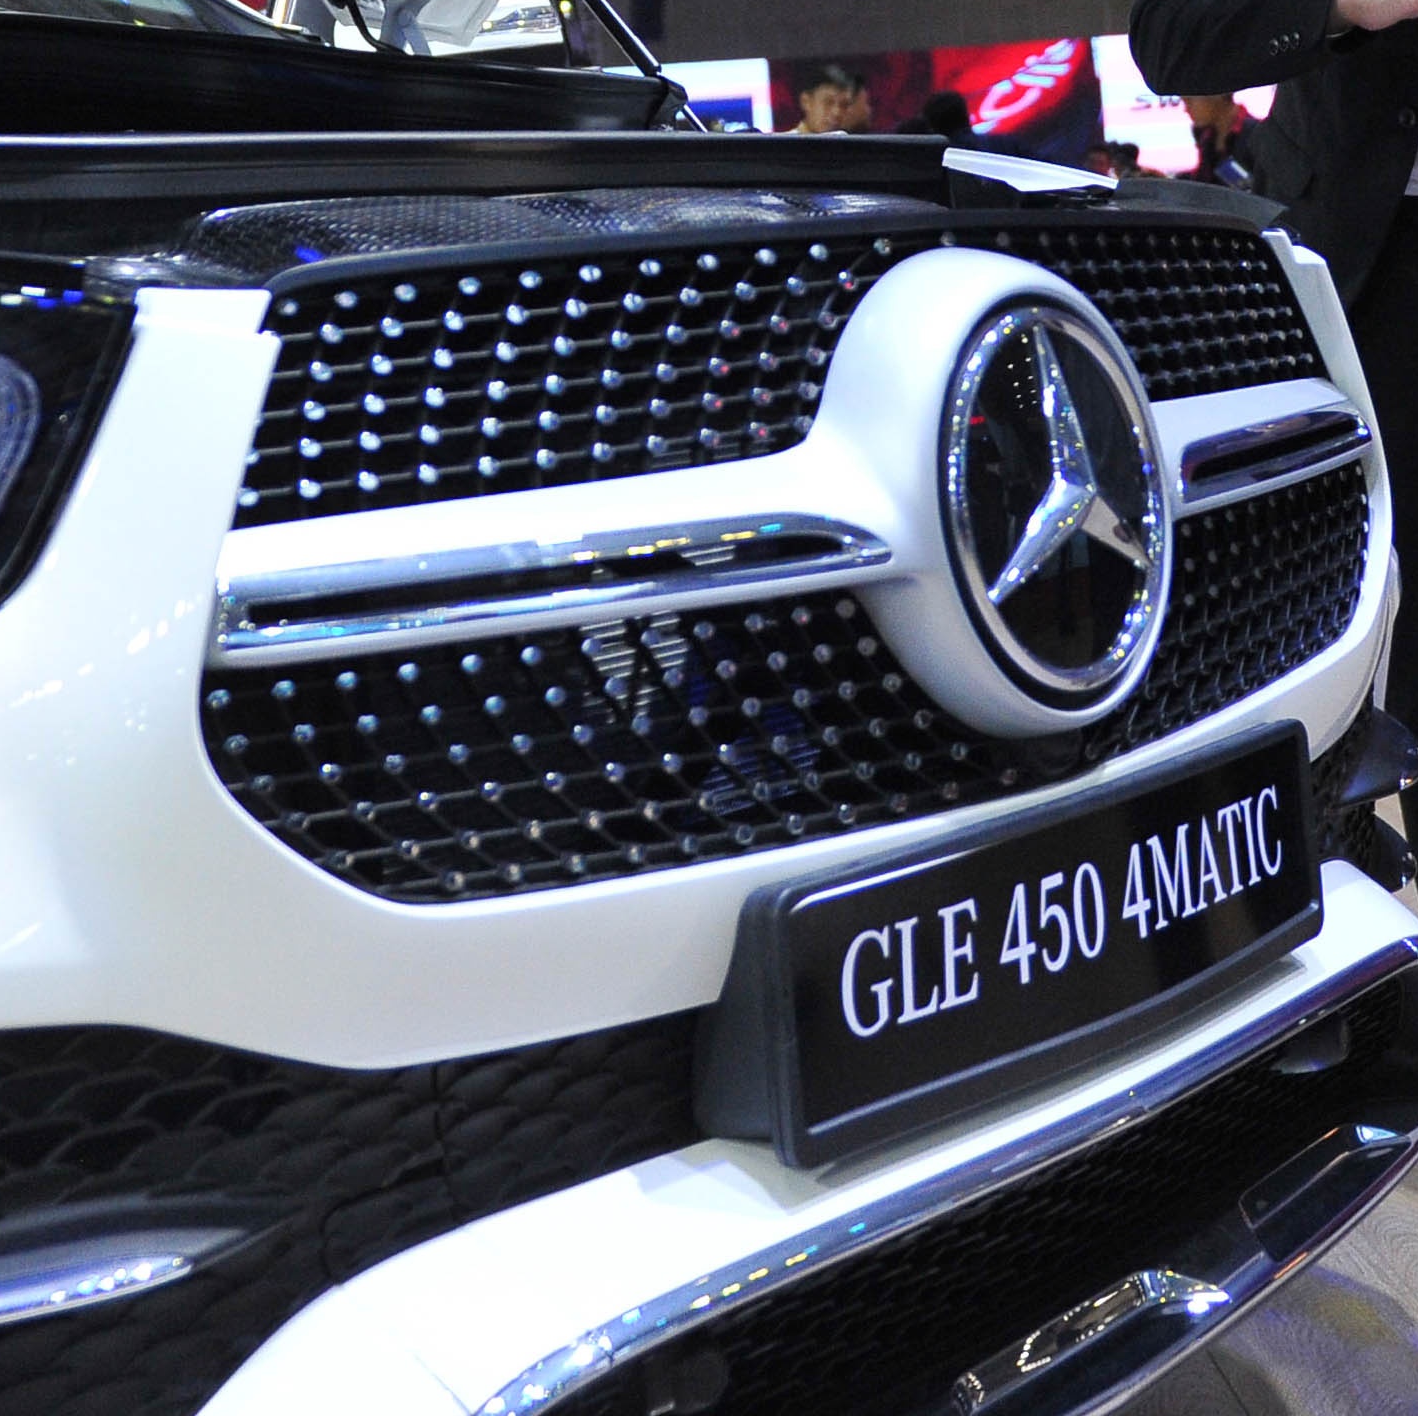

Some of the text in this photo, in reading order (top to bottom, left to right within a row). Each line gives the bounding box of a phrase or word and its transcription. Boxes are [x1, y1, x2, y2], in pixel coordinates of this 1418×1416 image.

[840, 784, 1282, 1038] GLE 450 4MATIC
